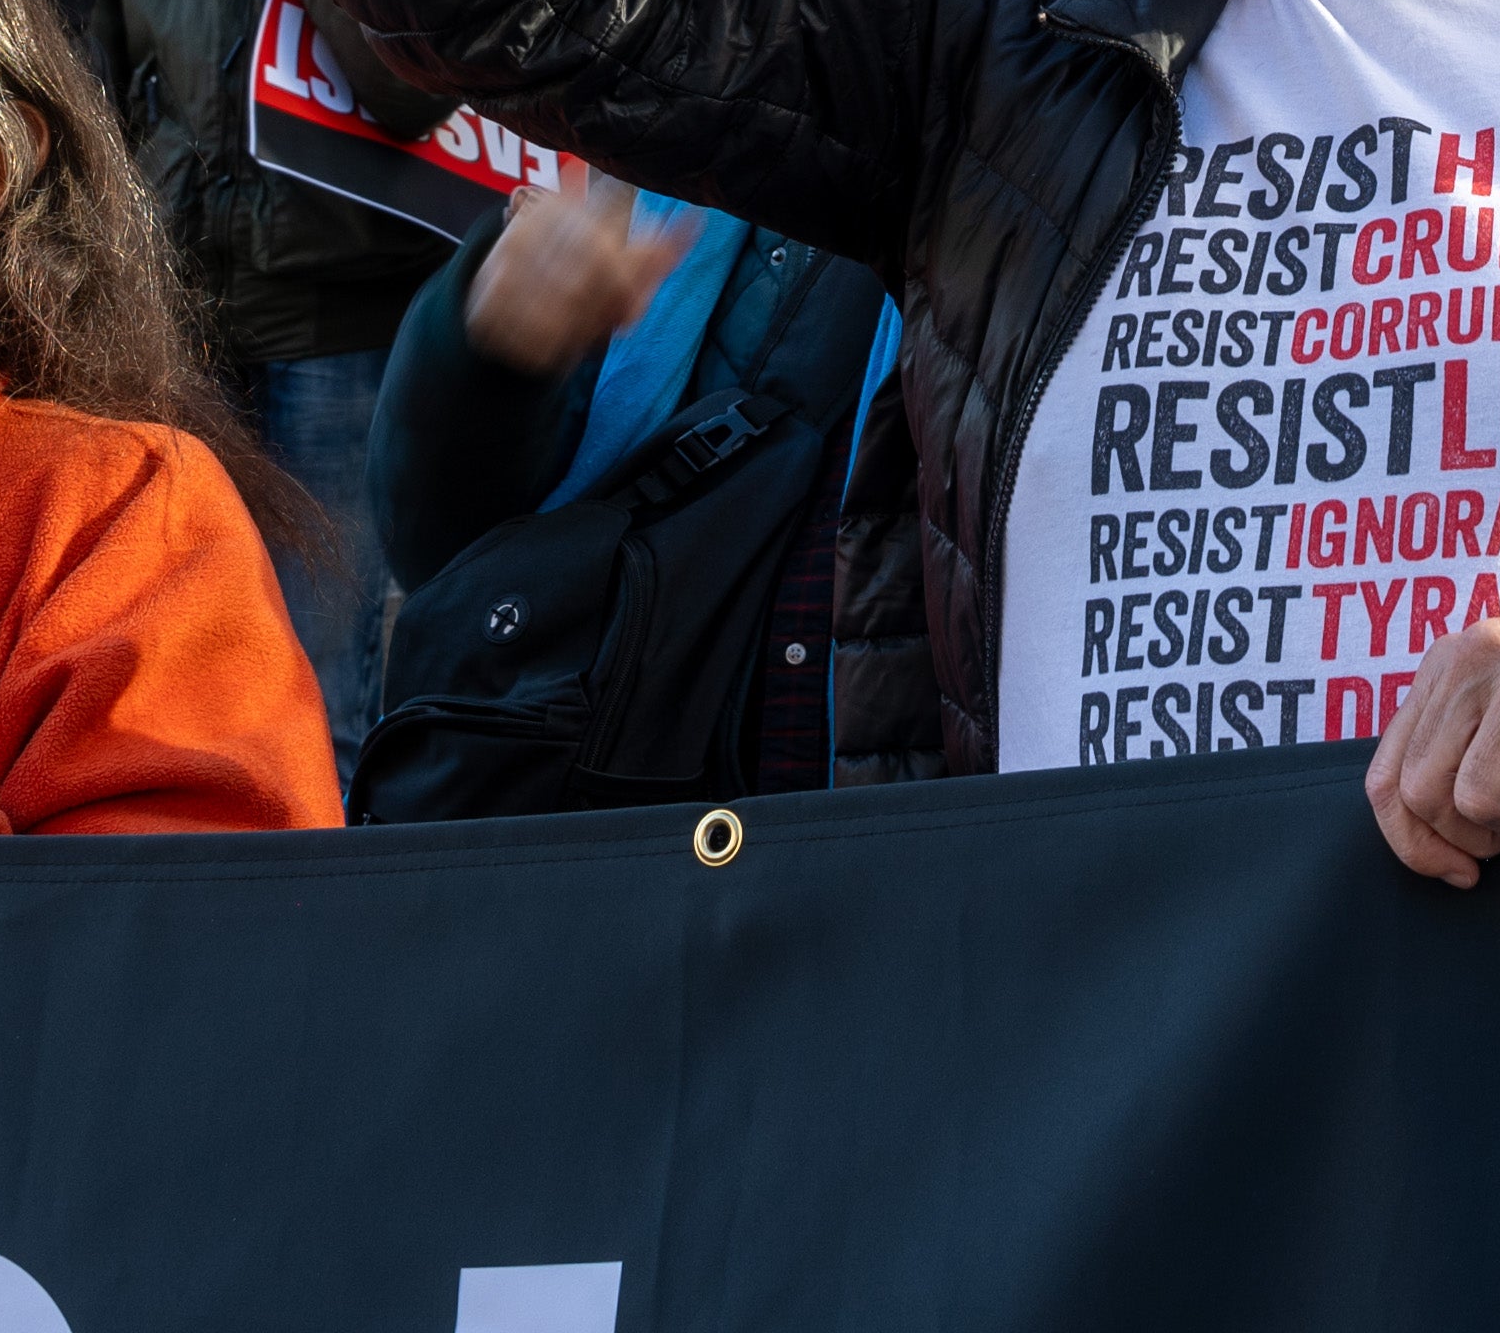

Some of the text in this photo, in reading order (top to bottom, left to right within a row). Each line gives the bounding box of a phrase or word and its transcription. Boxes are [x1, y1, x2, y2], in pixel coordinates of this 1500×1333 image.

[264, 0, 561, 194] FASST
[1155, 116, 1431, 220] RESIST
[1116, 222, 1357, 299] RESIST
[1101, 309, 1296, 372] RESIST
[1090, 362, 1437, 496] RESIST
[1088, 505, 1287, 584] RESIST
[1081, 585, 1302, 677] RESIST
[1078, 679, 1316, 766] RESIST
